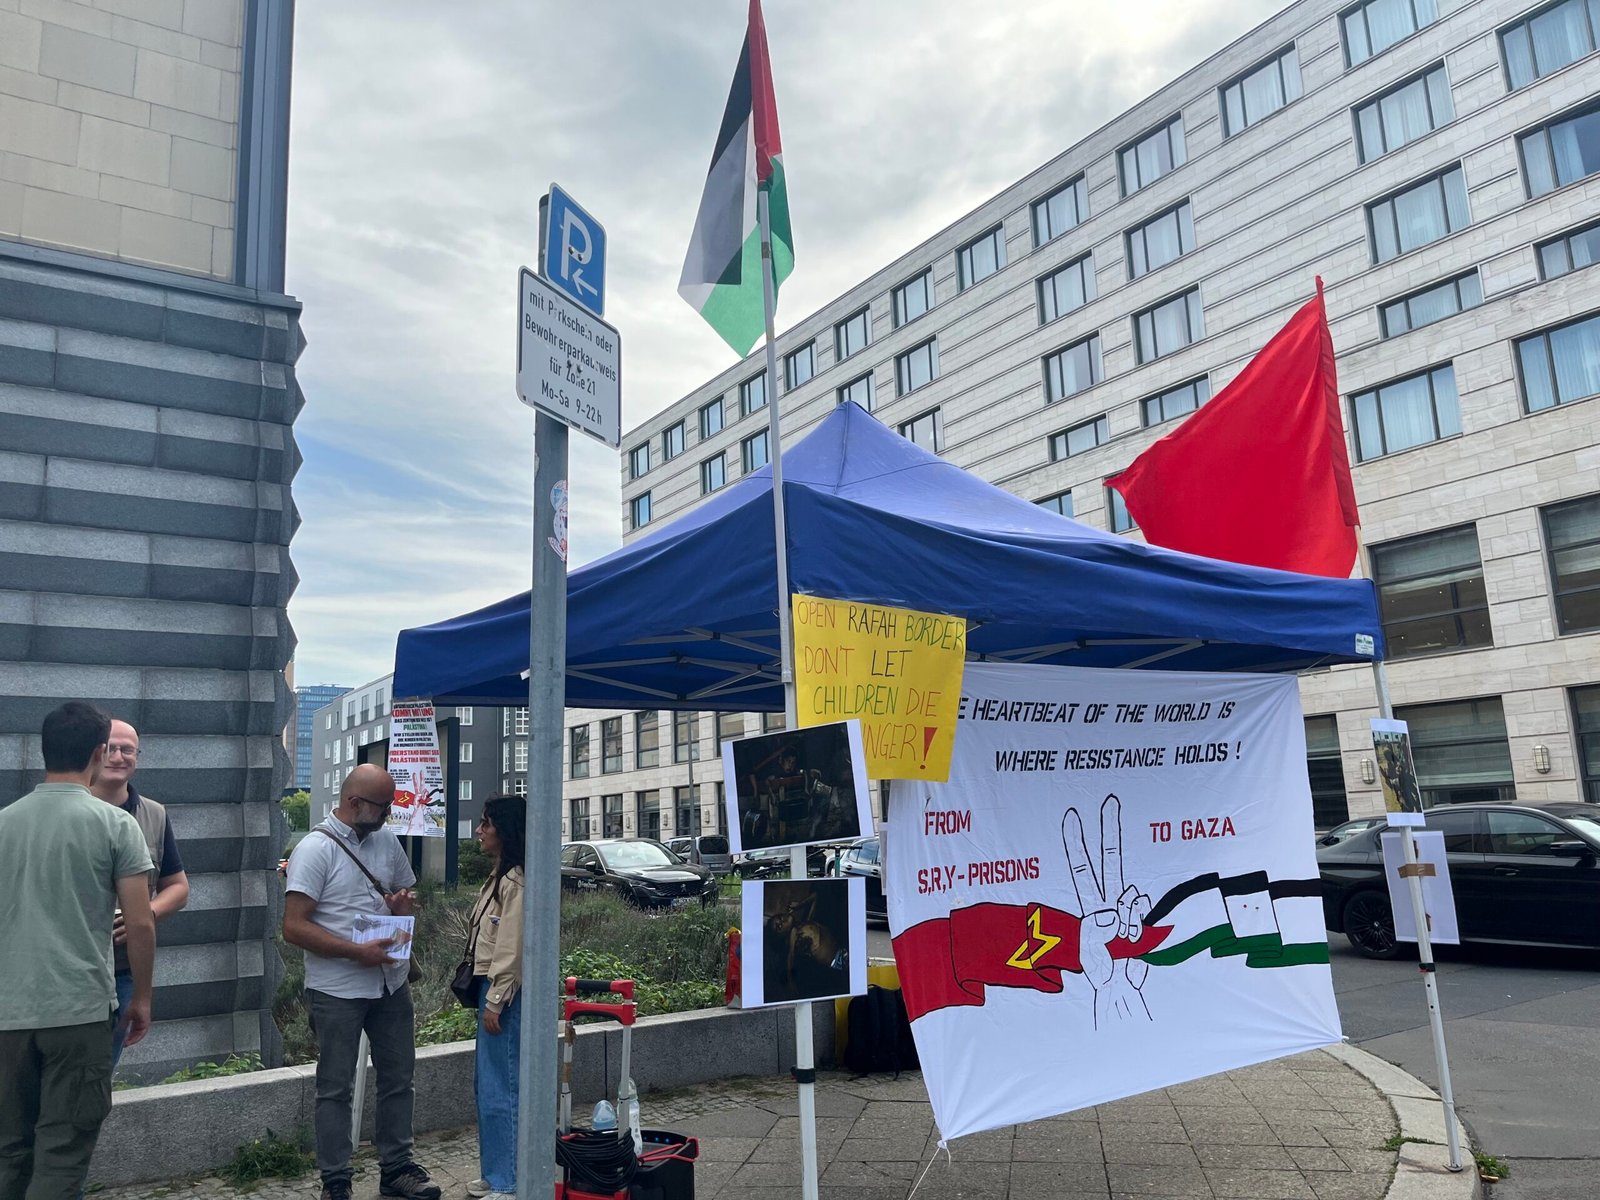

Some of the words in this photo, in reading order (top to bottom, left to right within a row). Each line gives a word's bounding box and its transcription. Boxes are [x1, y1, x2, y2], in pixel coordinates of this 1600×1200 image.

[561, 207, 592, 280] P
[529, 292, 544, 311] mit
[595, 335, 612, 354] oder
[549, 356, 561, 376] für
[587, 378, 596, 396] 21
[541, 379, 569, 408] Mo-Sa
[798, 601, 836, 628] OPEN
[849, 605, 897, 638] RAFAH
[905, 615, 965, 655] BORDER
[804, 645, 855, 677] DON'T
[871, 650, 912, 677] LET
[813, 683, 899, 715] CHILDREN
[905, 688, 941, 717] DIE
[972, 698, 1080, 723] HEARTBEAT
[1083, 703, 1107, 724] OF
[1114, 703, 1148, 724] THE
[1154, 701, 1212, 723] WORLD
[1218, 701, 1236, 719] IS
[862, 723, 938, 770] NGER!
[995, 750, 1058, 772] WHERE
[1064, 747, 1166, 770] RESISTANCE
[1174, 742, 1229, 766] HOLDS
[924, 809, 971, 836] FROM
[1149, 821, 1171, 844] TO
[1181, 816, 1236, 841] GAZA
